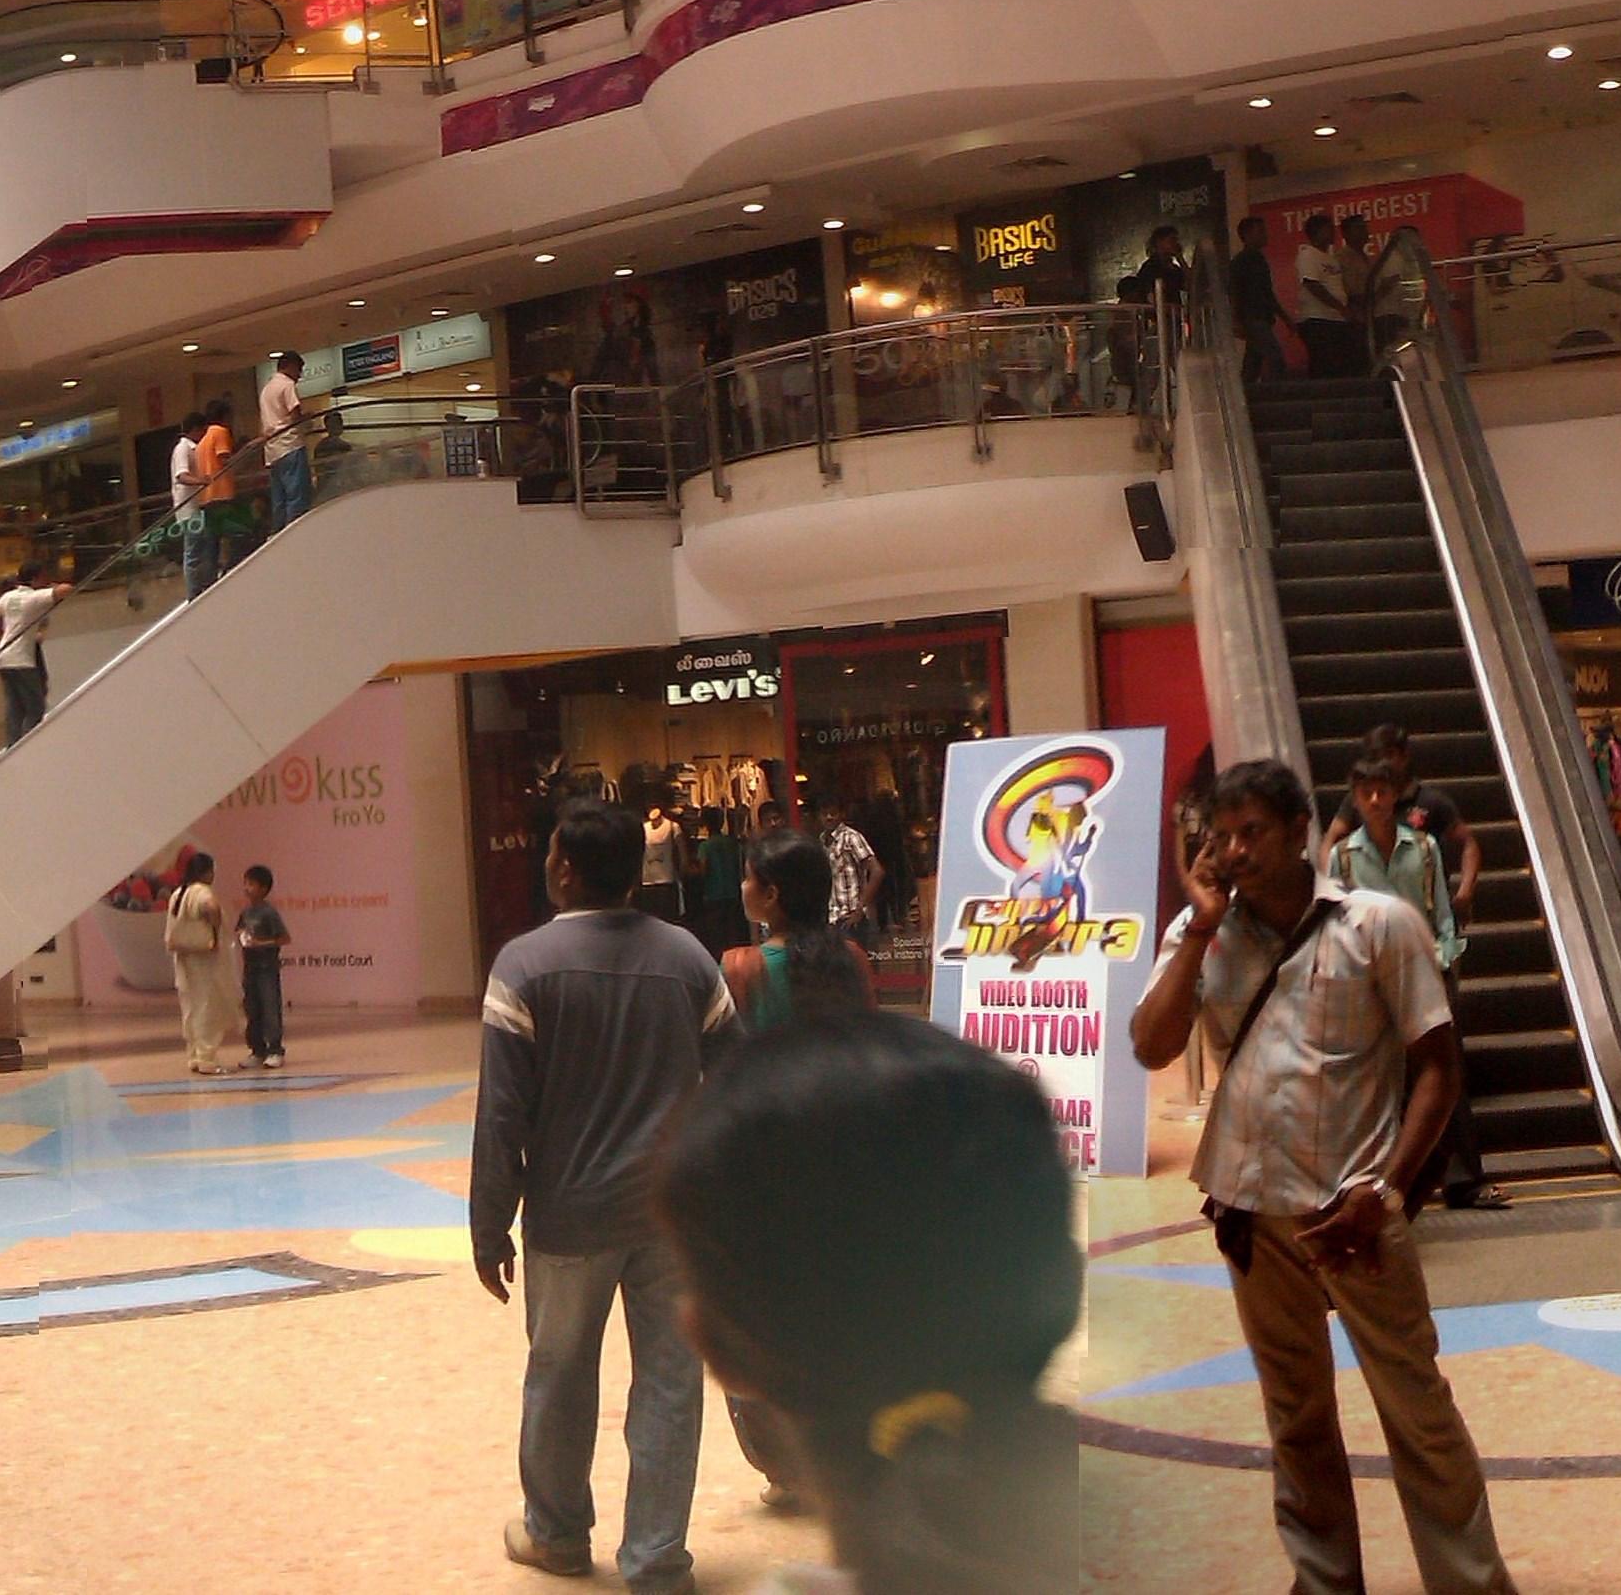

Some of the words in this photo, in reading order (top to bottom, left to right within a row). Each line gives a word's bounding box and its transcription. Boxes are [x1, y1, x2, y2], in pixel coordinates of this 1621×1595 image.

[1335, 191, 1432, 226] BIGGEST
[975, 214, 1058, 263] BASICS
[1000, 251, 1036, 269] LIFE
[725, 268, 798, 315] BASICS
[979, 980, 1027, 1008] VIDEO
[1031, 979, 1088, 1009] BOOTH
[961, 1010, 1101, 1057] AUDITION
